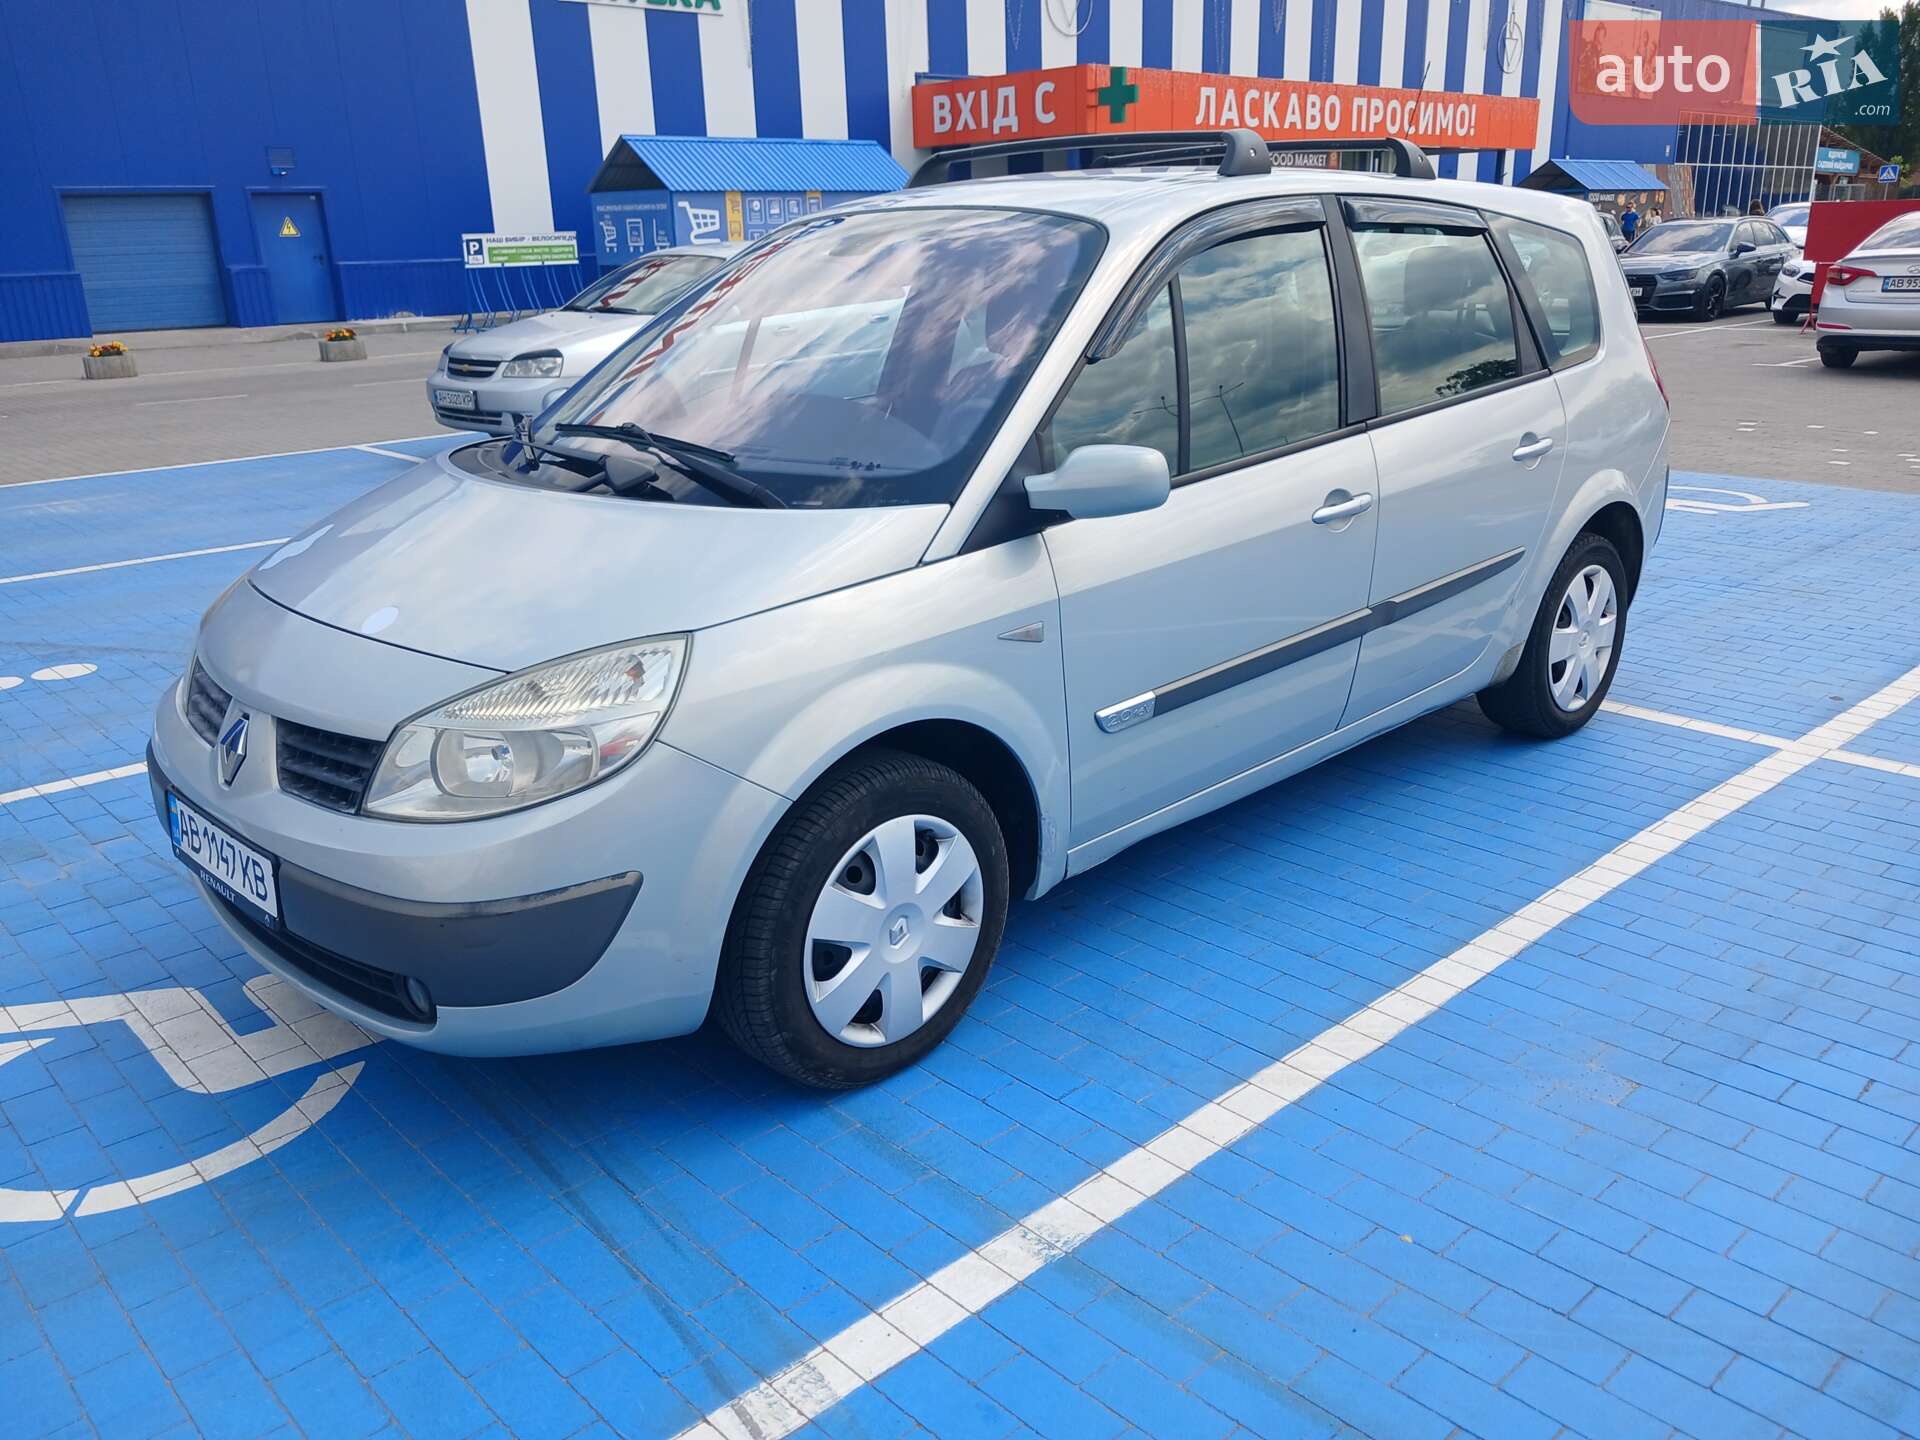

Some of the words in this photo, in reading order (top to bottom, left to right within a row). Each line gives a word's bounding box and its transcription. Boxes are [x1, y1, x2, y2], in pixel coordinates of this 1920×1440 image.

[932, 86, 1019, 134] ВХІД
[1034, 81, 1056, 124] С
[1195, 87, 1341, 131] ЛАСКАВО
[1351, 97, 1477, 137] ПРОСИМО!
[1294, 153, 1327, 167] MARKET
[486, 236, 503, 244] НАШ
[200, 870, 236, 903] RENAULT
